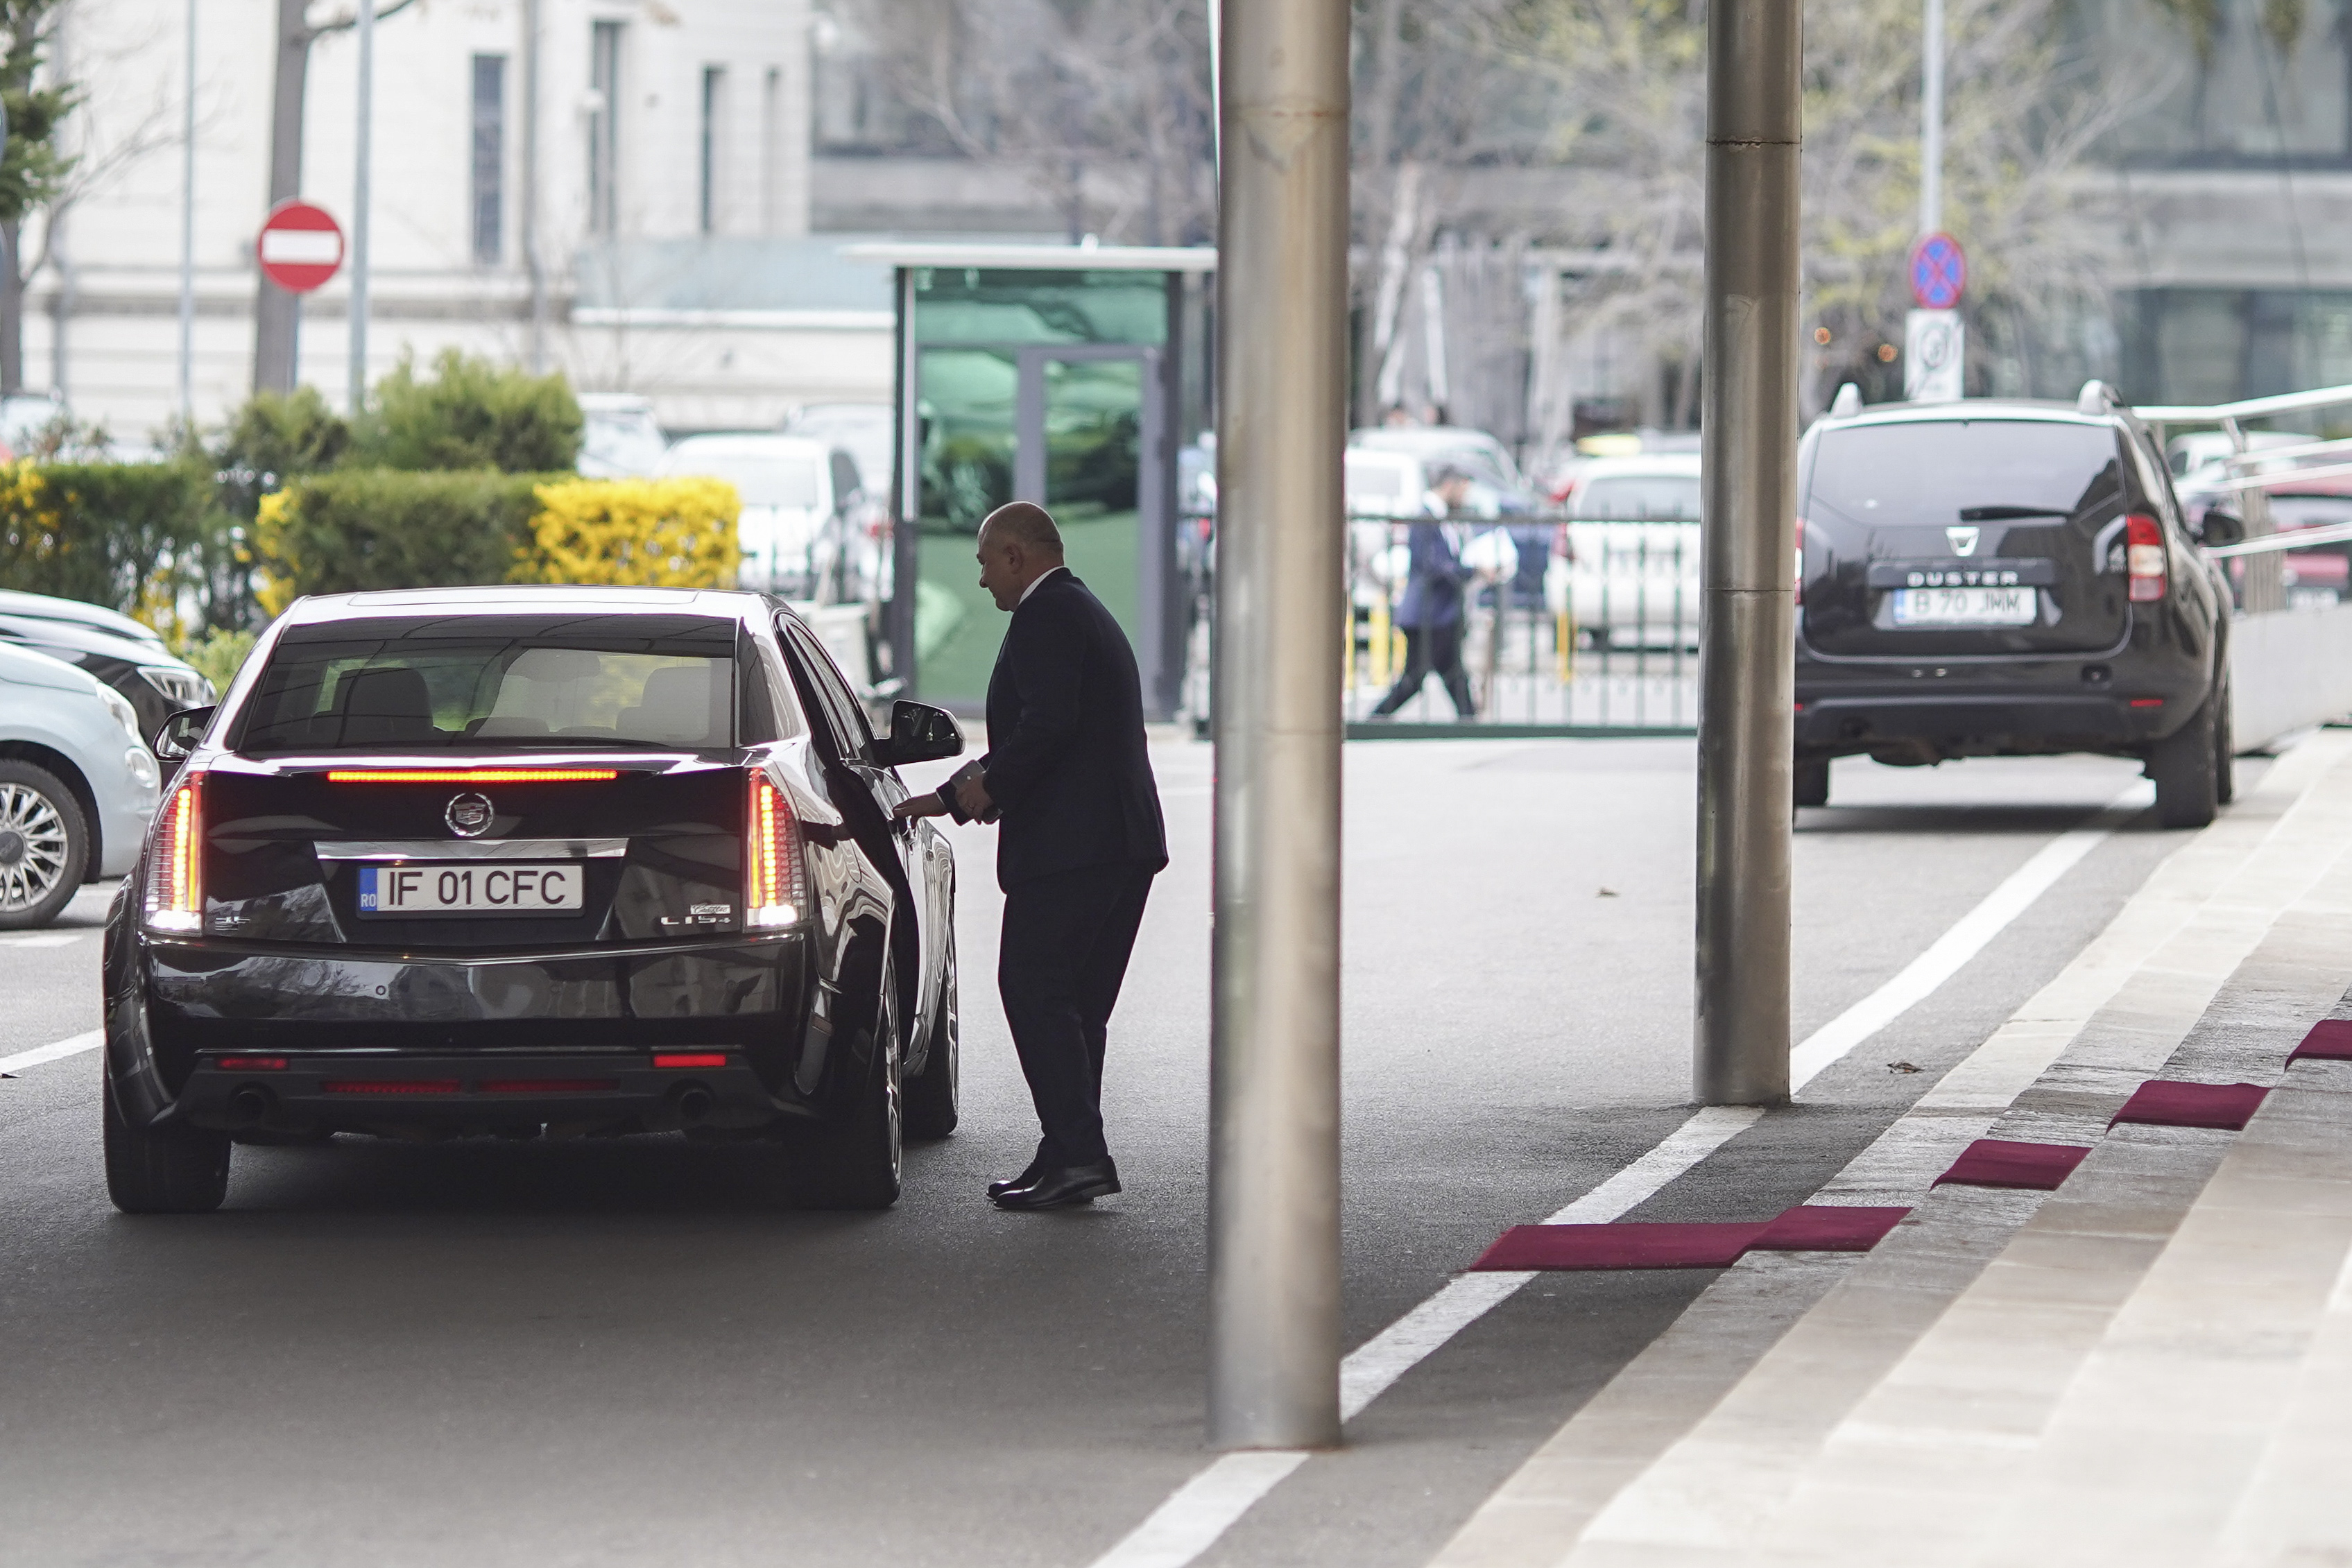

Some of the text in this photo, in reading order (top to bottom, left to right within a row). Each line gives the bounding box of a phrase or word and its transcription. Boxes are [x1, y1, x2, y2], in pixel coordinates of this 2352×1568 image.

[1907, 571, 2018, 587] DUSTER
[1914, 592, 1931, 614] B
[1939, 592, 1968, 614] 70
[388, 870, 566, 906] IF 01 CFC
[361, 893, 377, 908] RO
